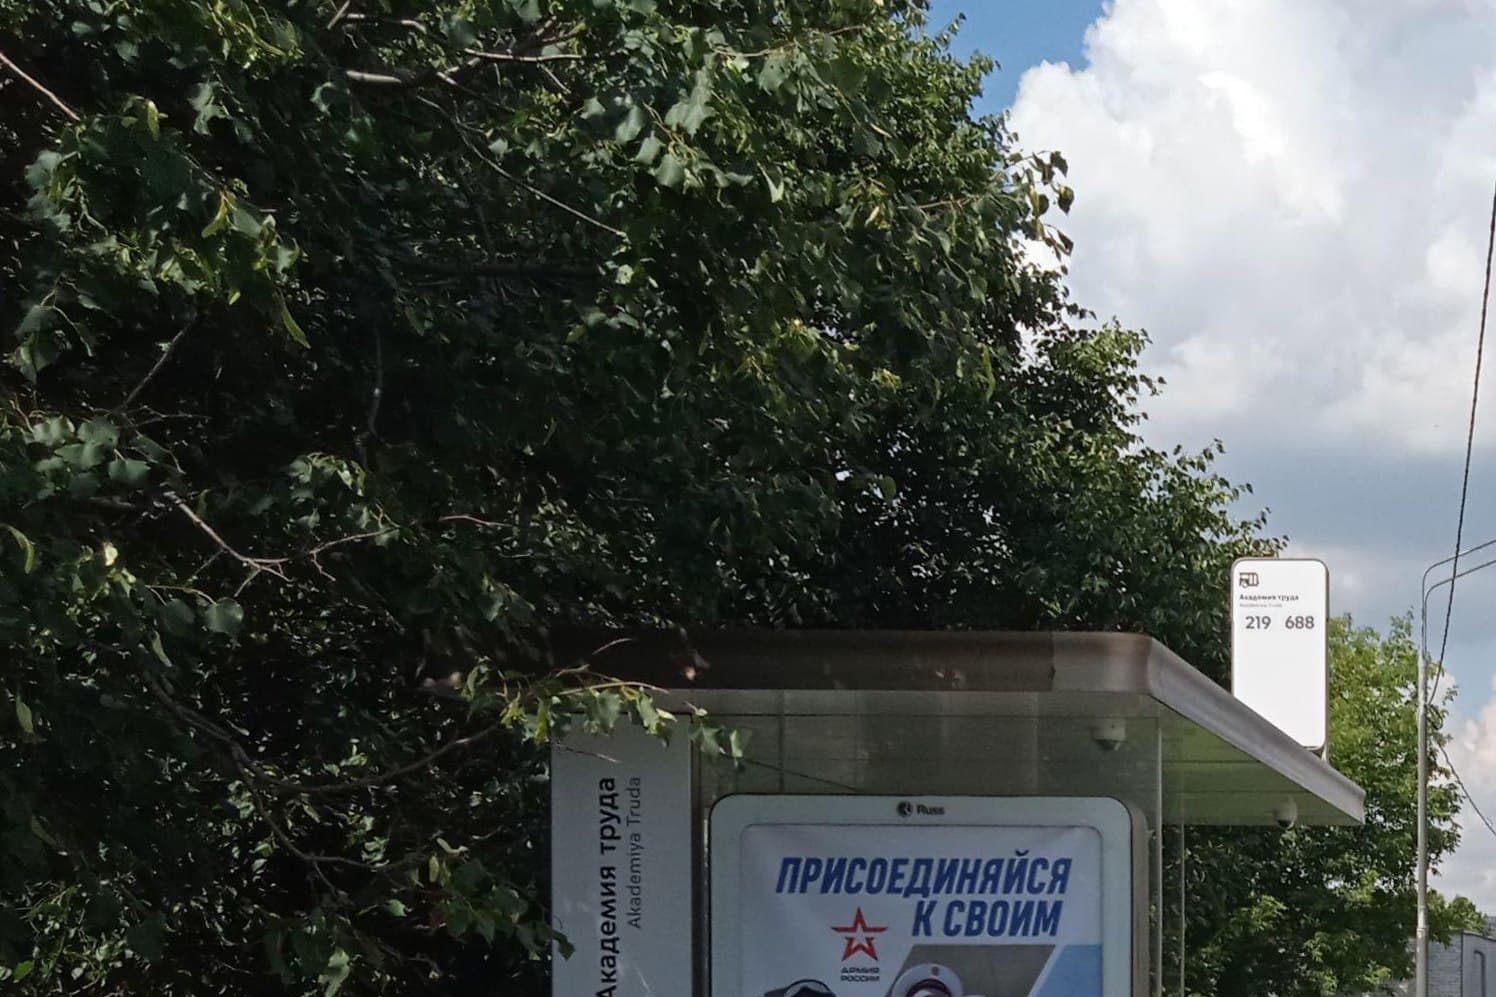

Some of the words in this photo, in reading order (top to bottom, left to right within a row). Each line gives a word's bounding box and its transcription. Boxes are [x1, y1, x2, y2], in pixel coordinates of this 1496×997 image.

[1245, 615, 1272, 630] 219
[1285, 615, 1315, 630] 688
[599, 777, 621, 855] труда
[626, 776, 641, 827] Truda
[916, 805, 945, 815] Russ
[627, 832, 644, 929] Akademiya
[775, 850, 1072, 898] ПРИСОЕДИНЯЙСЯ
[912, 900, 937, 936] К
[943, 900, 1063, 936] СВОИМ
